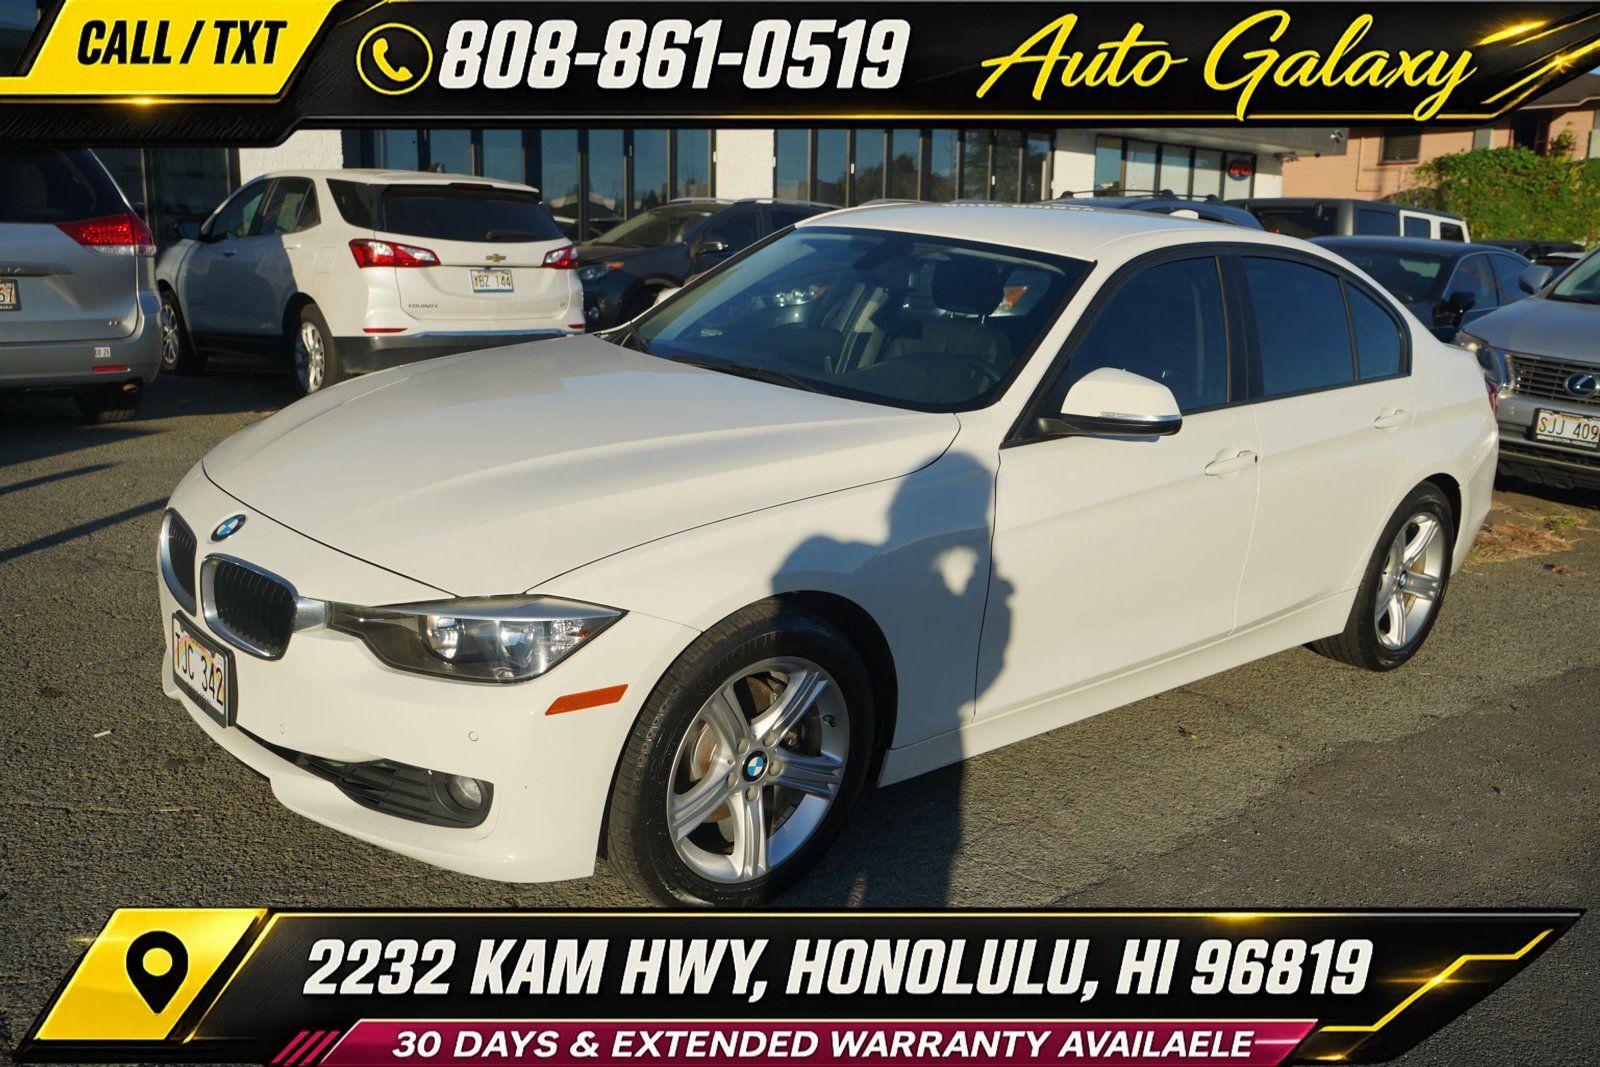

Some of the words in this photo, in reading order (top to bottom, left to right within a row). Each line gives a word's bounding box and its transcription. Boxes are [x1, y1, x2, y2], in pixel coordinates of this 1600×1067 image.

[1539, 416, 1567, 435] SJJ
[1573, 422, 1600, 440] 409
[175, 632, 194, 680] TJC
[201, 655, 224, 706] 342
